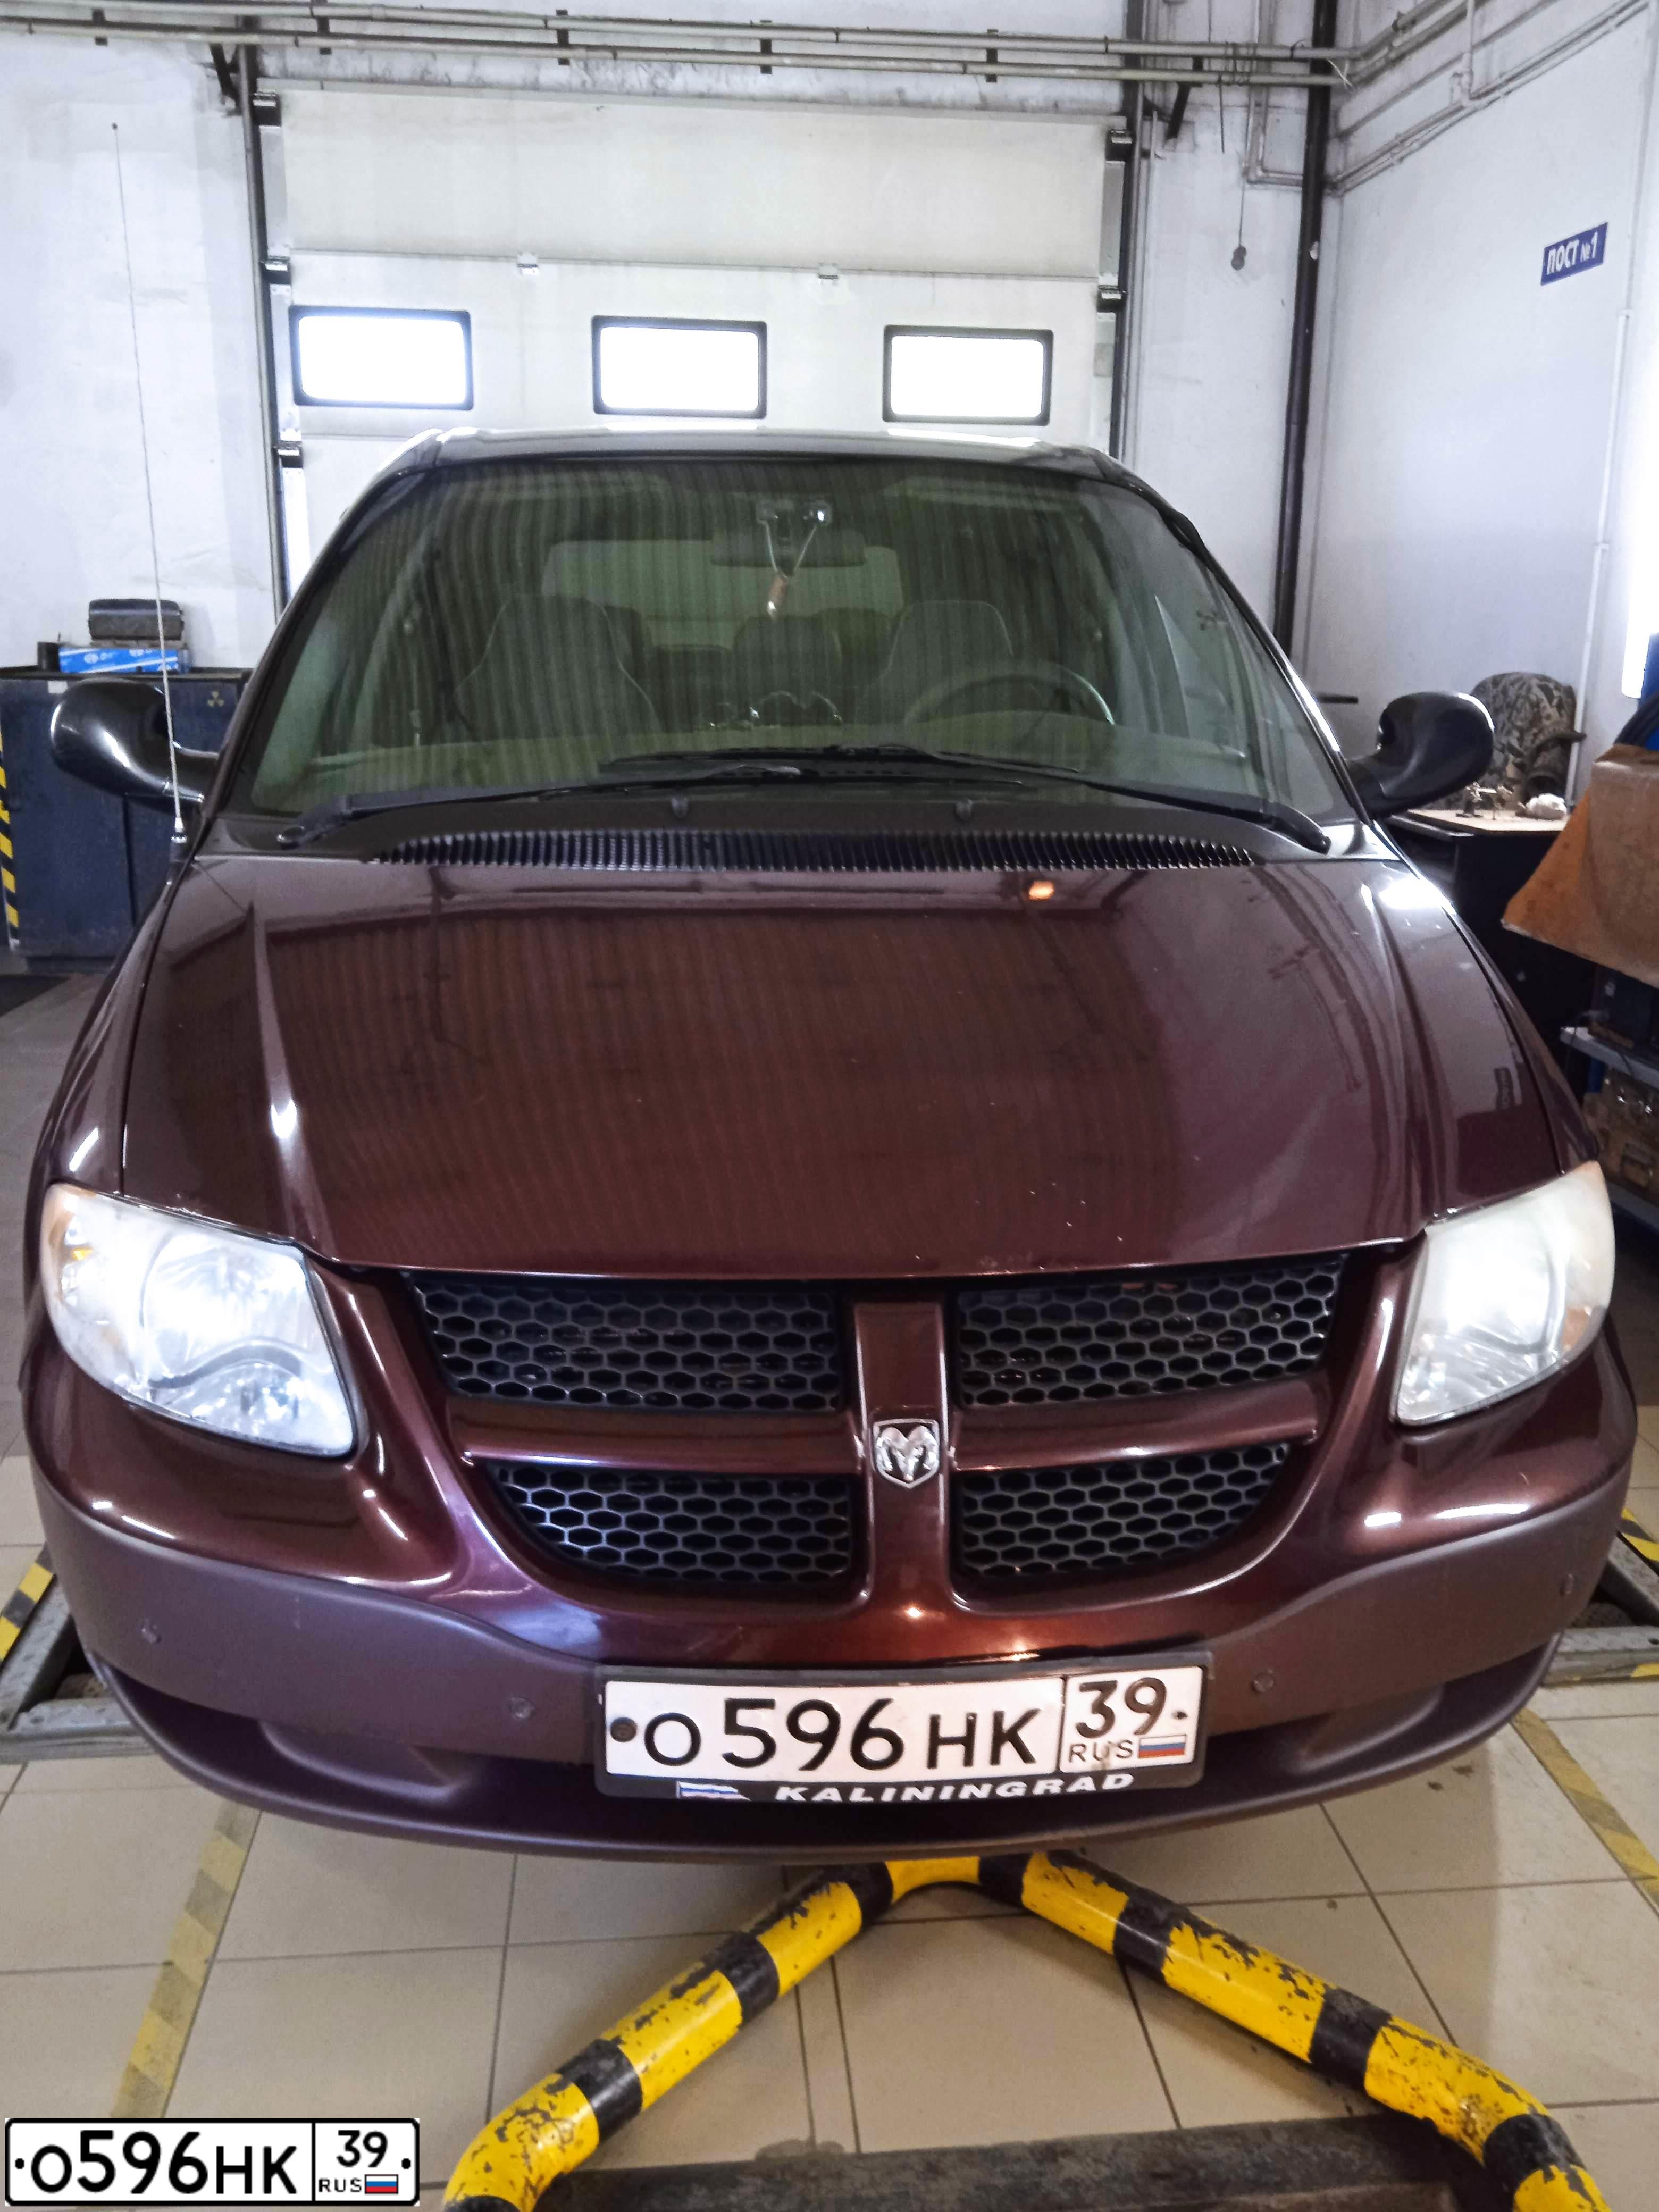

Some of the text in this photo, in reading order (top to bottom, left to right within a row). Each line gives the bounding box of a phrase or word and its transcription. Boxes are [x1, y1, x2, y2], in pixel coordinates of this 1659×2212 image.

[1546, 239, 1580, 275] ПОСТ
[1075, 1677, 1167, 1739] 39
[1068, 1739, 1133, 1763] RUS
[774, 1773, 1134, 1803] KALININGRAD
